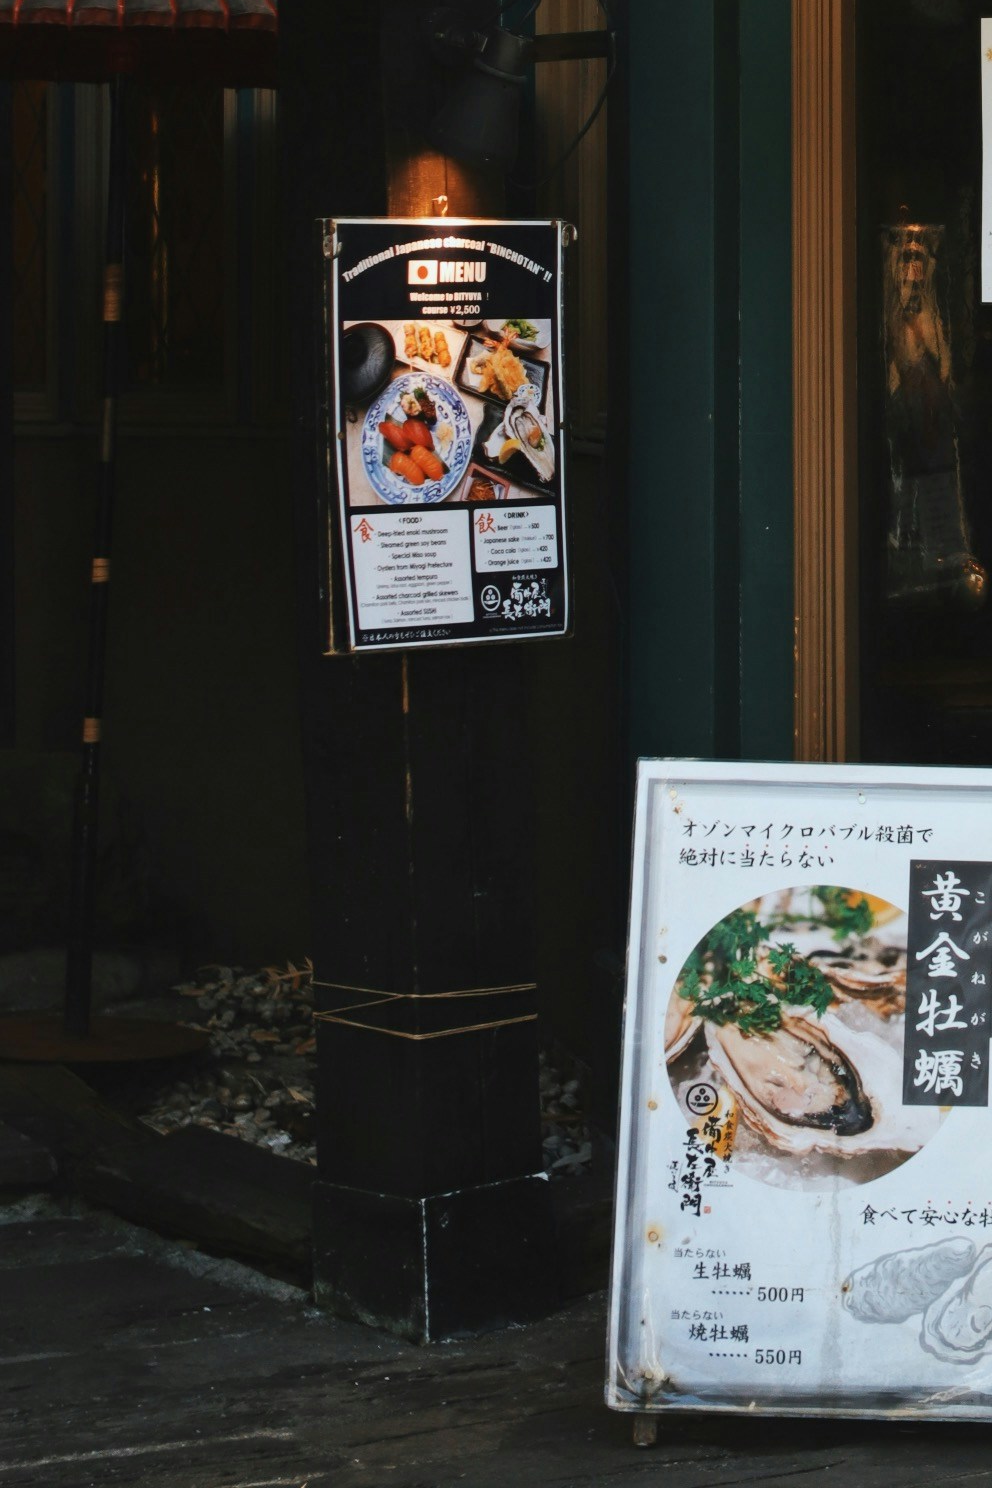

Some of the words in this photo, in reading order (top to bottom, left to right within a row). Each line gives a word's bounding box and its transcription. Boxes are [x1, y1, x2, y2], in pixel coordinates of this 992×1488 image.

[342, 246, 395, 283] Traditional
[395, 237, 443, 254] Japanese
[439, 261, 487, 283] MENU
[450, 304, 481, 316] ¥2,500
[354, 518, 375, 543] 食
[475, 513, 496, 534] 飲
[682, 819, 935, 845] オゾンマイクロバブル殺菌で
[678, 846, 835, 869] 絶対に当たらない
[913, 870, 971, 1098] 黄金牡蠣
[673, 1248, 727, 1259] 当たらない
[692, 1261, 752, 1281] 生牡蠣
[757, 1286, 805, 1303] 500円
[670, 1309, 724, 1321] 当たらない
[688, 1322, 750, 1344] 焼牡蠣
[755, 1348, 802, 1365] 550円
